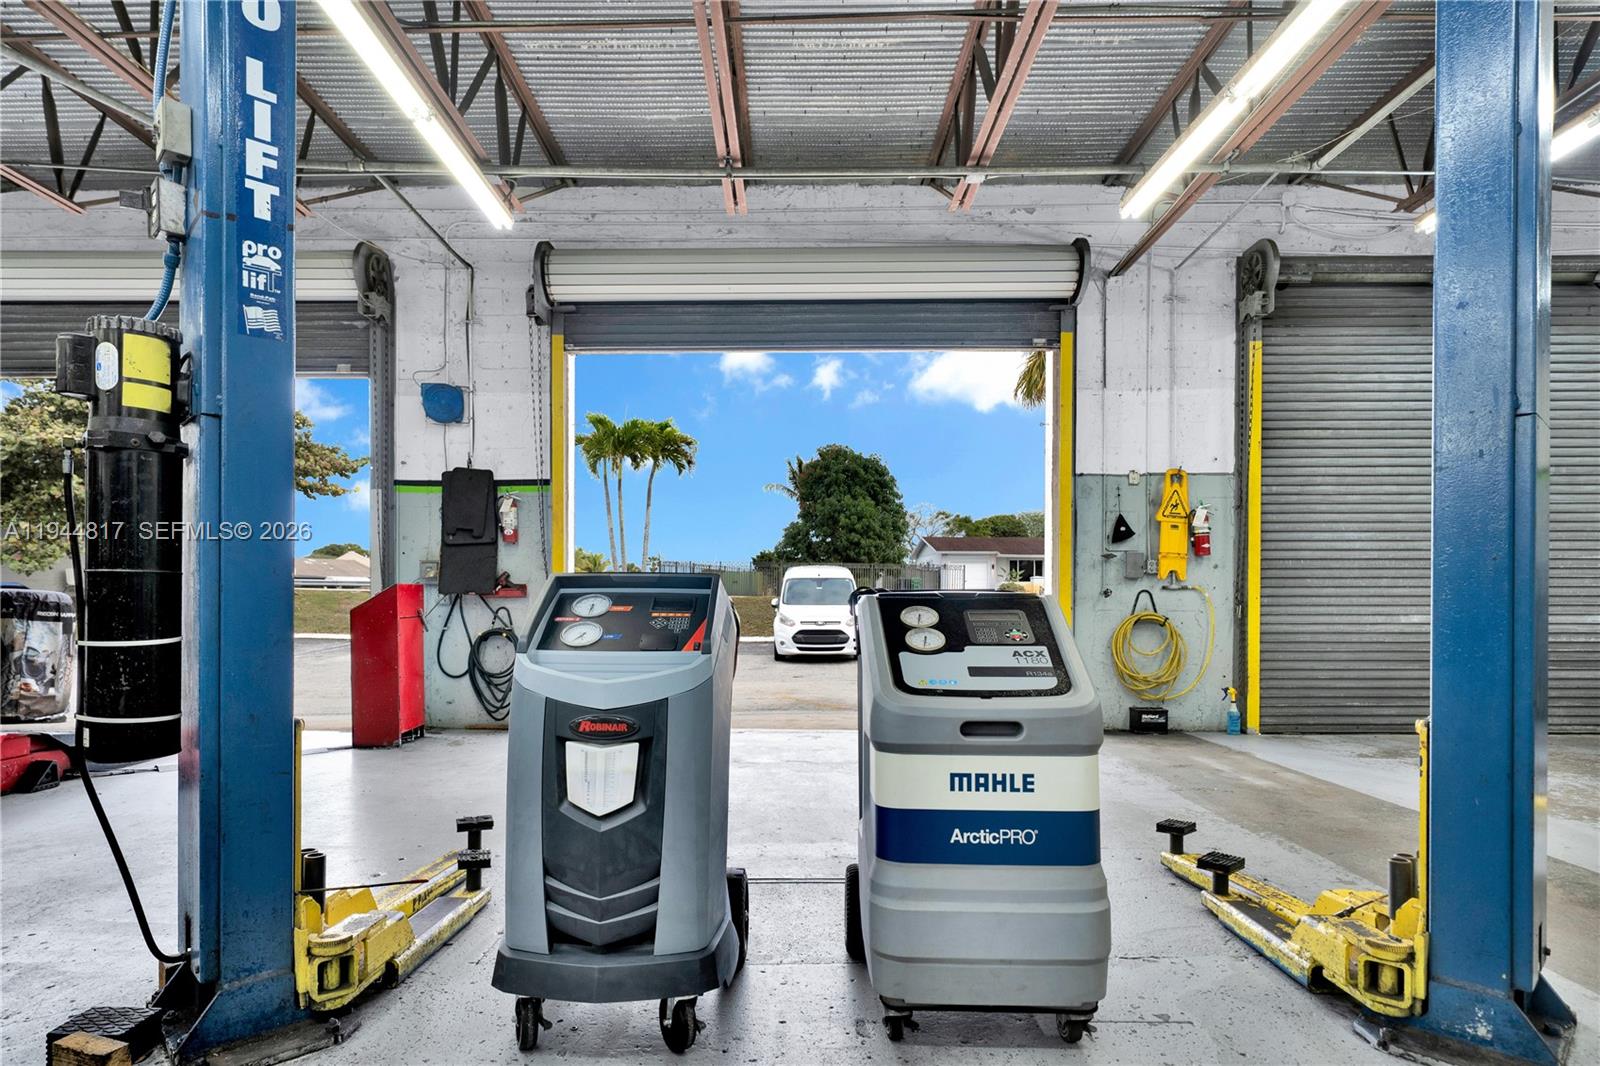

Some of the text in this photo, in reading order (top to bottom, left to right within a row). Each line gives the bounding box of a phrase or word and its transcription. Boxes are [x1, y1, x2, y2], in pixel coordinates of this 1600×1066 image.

[244, 55, 280, 222] LIFT
[242, 240, 283, 260] pro
[1012, 650, 1047, 658] ACX
[1015, 657, 1049, 665] 1180
[578, 720, 628, 732] ROBINAIR
[949, 772, 1035, 793] MAHLE
